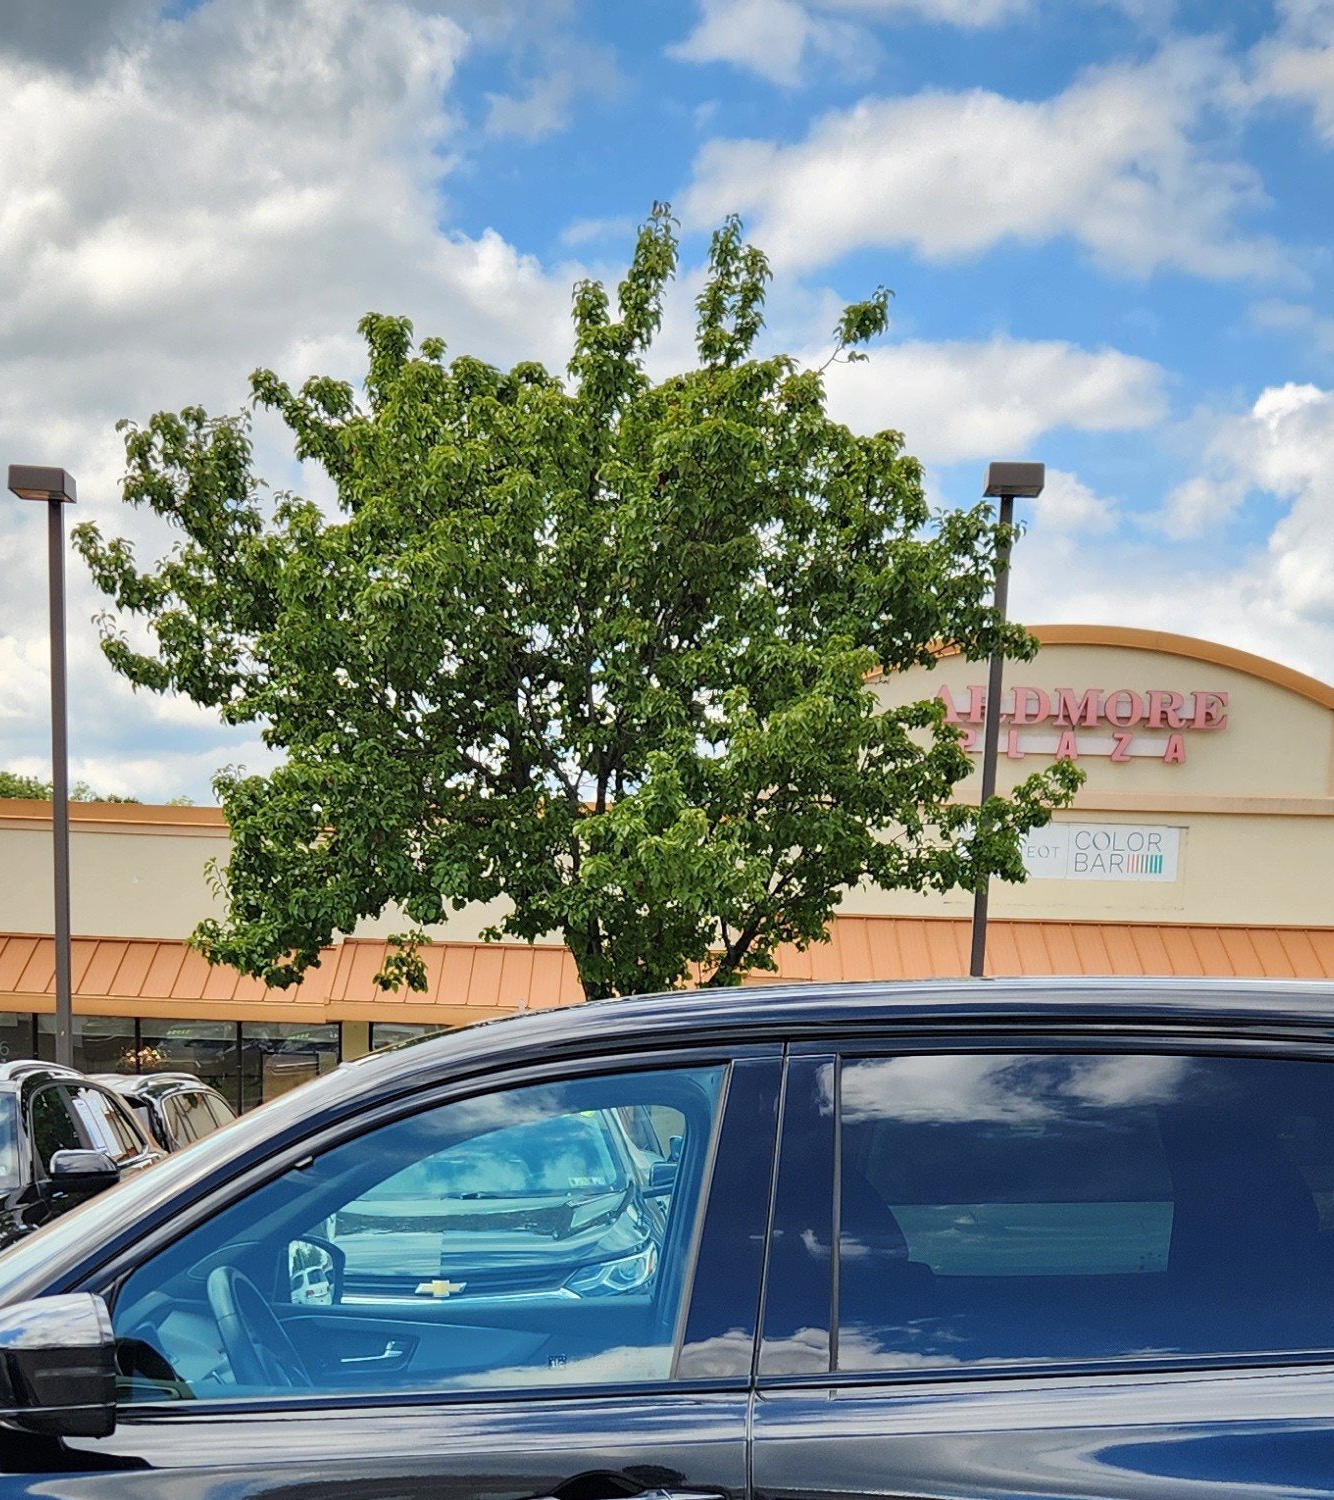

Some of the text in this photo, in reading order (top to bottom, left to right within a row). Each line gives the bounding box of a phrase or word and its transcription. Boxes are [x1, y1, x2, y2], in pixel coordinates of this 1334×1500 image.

[957, 727, 1187, 764] PLAZA
[1074, 830, 1163, 853] COLOR
[1074, 852, 1125, 873] BAR
